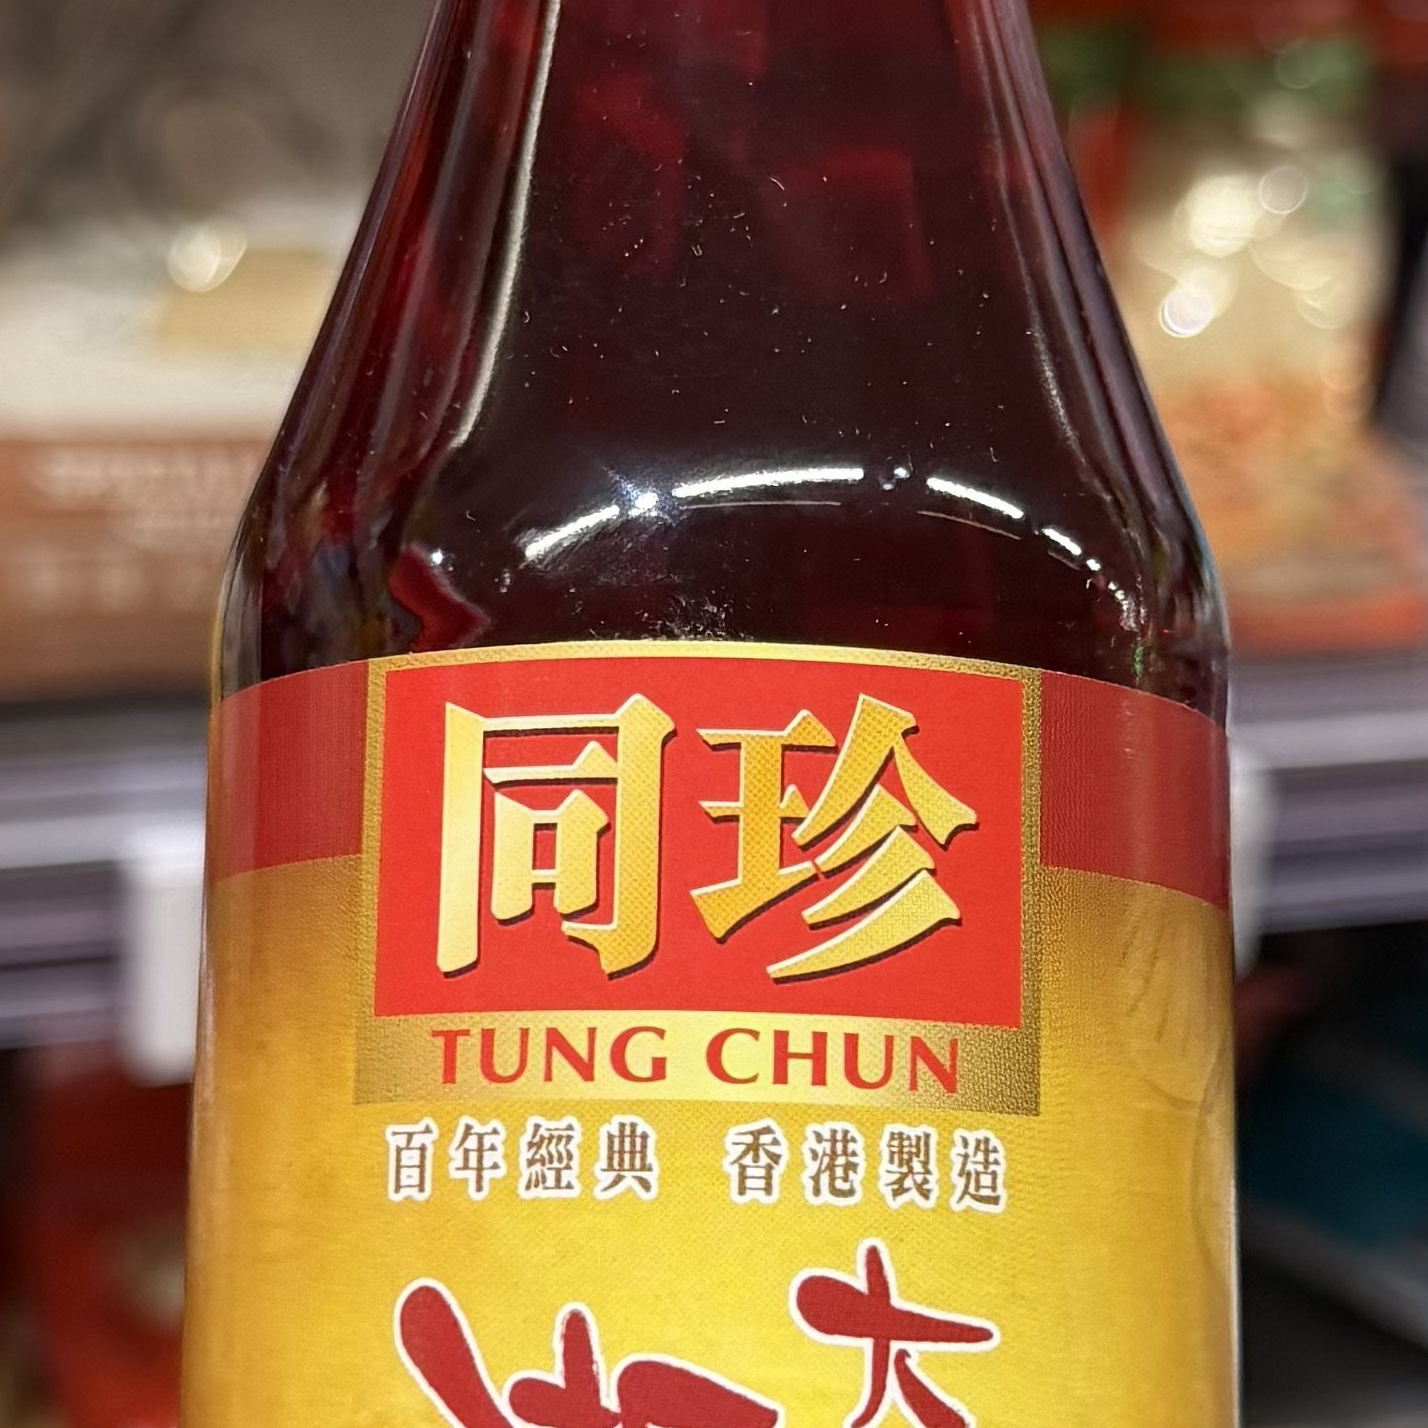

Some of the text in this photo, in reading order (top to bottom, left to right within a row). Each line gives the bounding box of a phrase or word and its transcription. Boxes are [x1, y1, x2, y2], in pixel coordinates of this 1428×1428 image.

[435, 692, 982, 984] 同珍
[431, 1027, 960, 1095] TUNG CHUN
[388, 1121, 1008, 1209] 百年經典 香港製造
